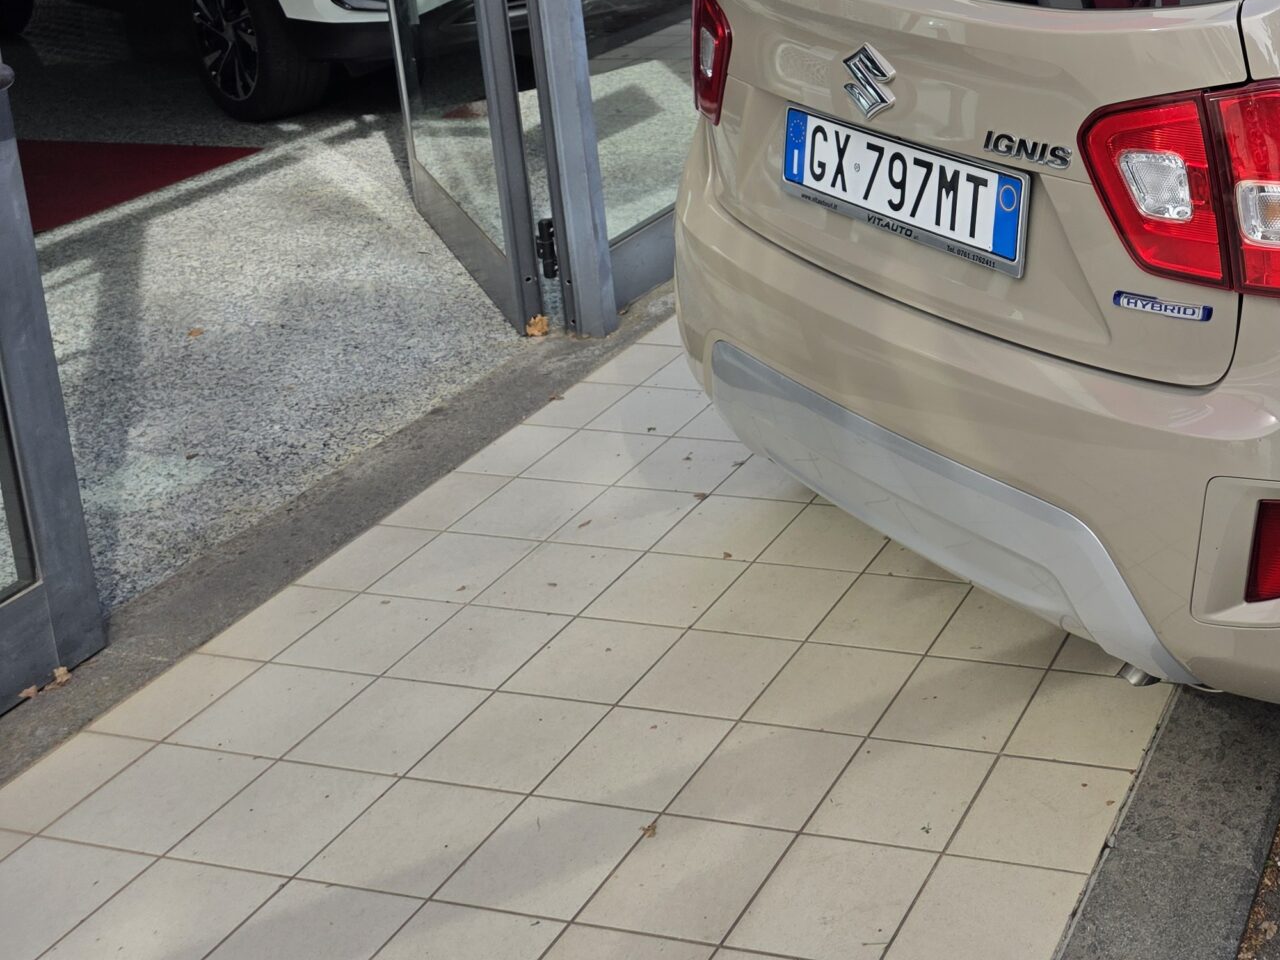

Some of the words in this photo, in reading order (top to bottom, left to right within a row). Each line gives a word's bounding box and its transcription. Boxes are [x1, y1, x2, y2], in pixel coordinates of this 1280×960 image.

[983, 130, 1072, 169] IGNIS
[809, 125, 851, 192] GX
[862, 142, 989, 239] 797MT
[1126, 298, 1196, 316] HYBRID
